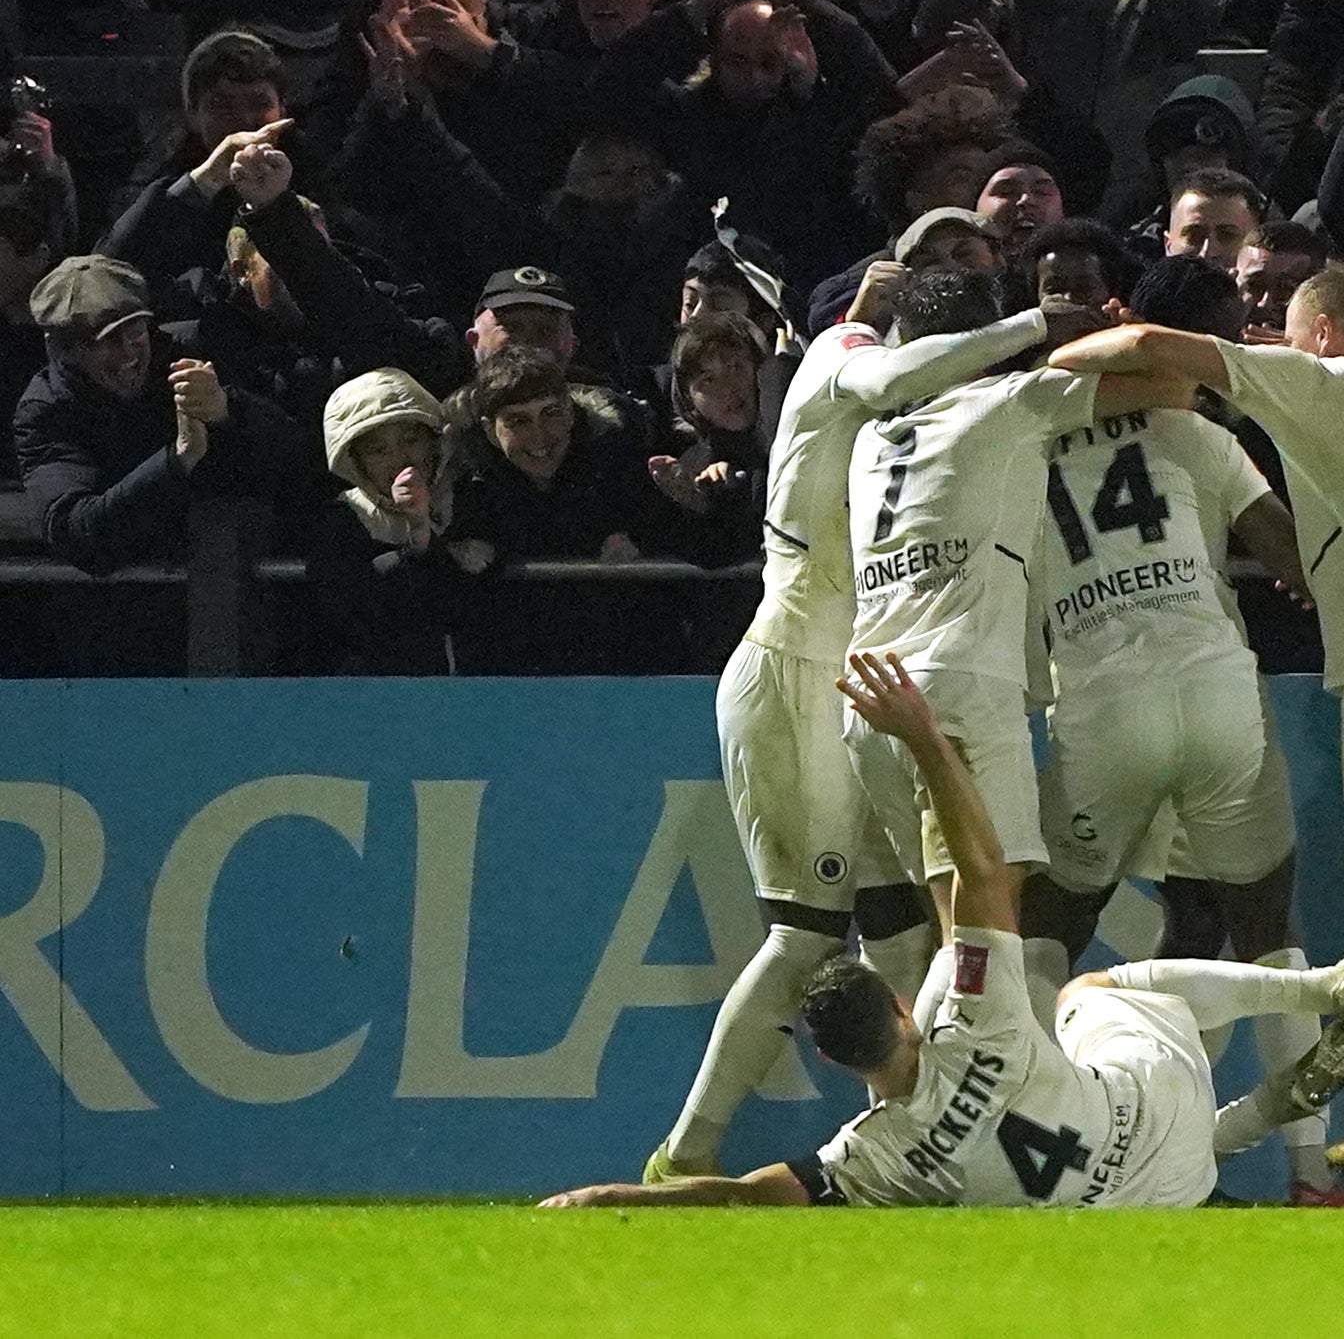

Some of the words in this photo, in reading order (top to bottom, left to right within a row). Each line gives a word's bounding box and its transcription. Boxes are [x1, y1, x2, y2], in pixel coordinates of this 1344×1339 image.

[1046, 441, 1170, 564] 14
[1055, 560, 1172, 626] PIONEER
[1172, 556, 1196, 573] FM
[1113, 588, 1204, 619] Management
[903, 1048, 1006, 1179] RICKETTS
[996, 1109, 1094, 1201] 4
